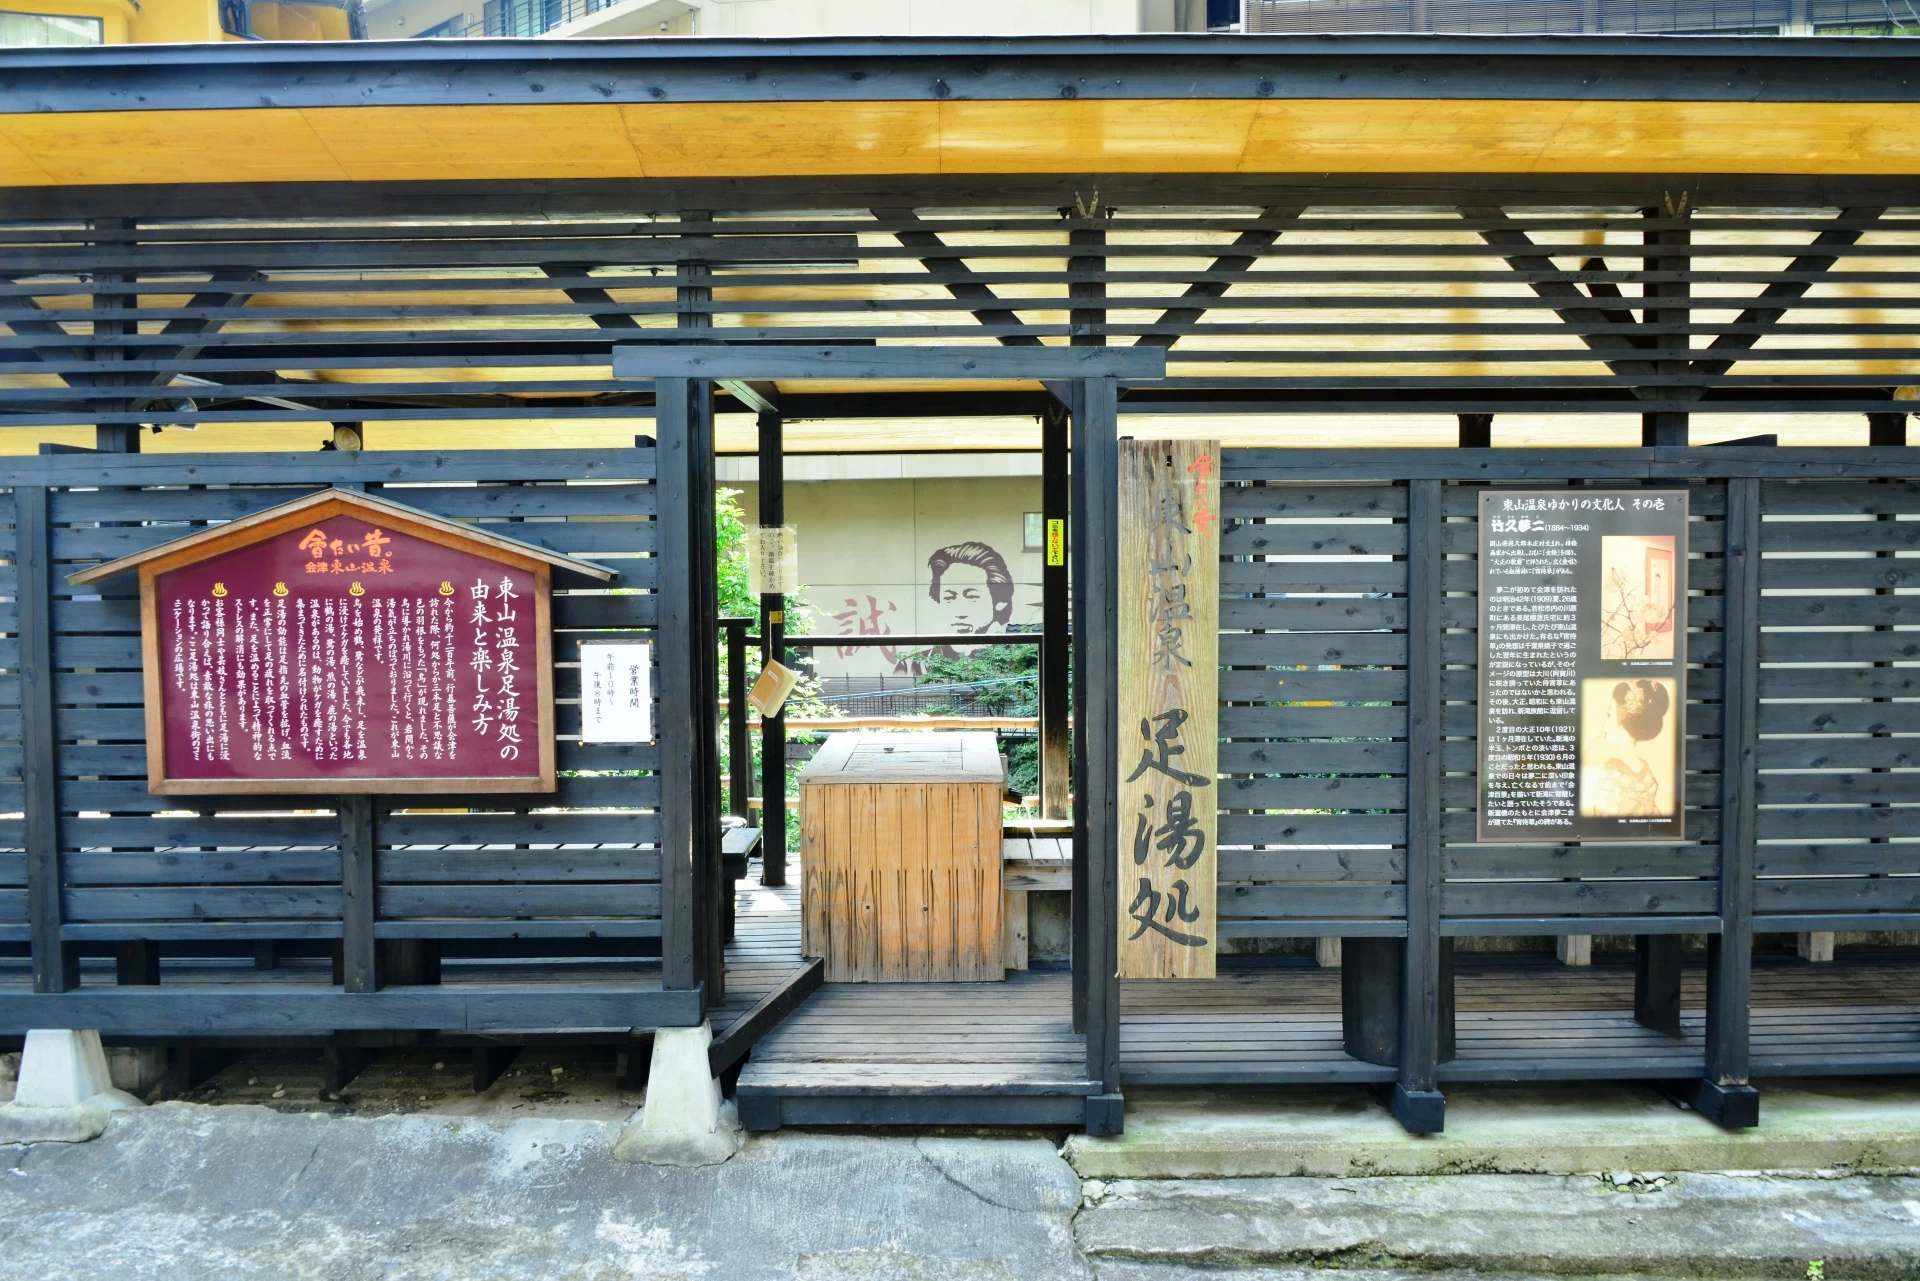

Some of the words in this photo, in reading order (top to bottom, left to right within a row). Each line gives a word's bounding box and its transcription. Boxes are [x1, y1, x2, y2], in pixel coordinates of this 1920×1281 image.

[1501, 498, 1625, 512] 東山温泉ゆかりの文化人
[1632, 498, 1665, 511] その壱
[371, 598, 385, 665] 温泉の発祥です。
[832, 595, 898, 665] 誠
[1148, 488, 1192, 668] 東山温泉
[443, 598, 458, 760] 今から約千二百年前、行基菩薩が会津を
[469, 578, 495, 735] 由来と楽しみ方
[494, 577, 523, 761] 東山温泉足湯処の
[593, 671, 602, 724] 午後8時まで
[628, 664, 639, 708] 営業時間
[1126, 708, 1211, 948] 足湯処
